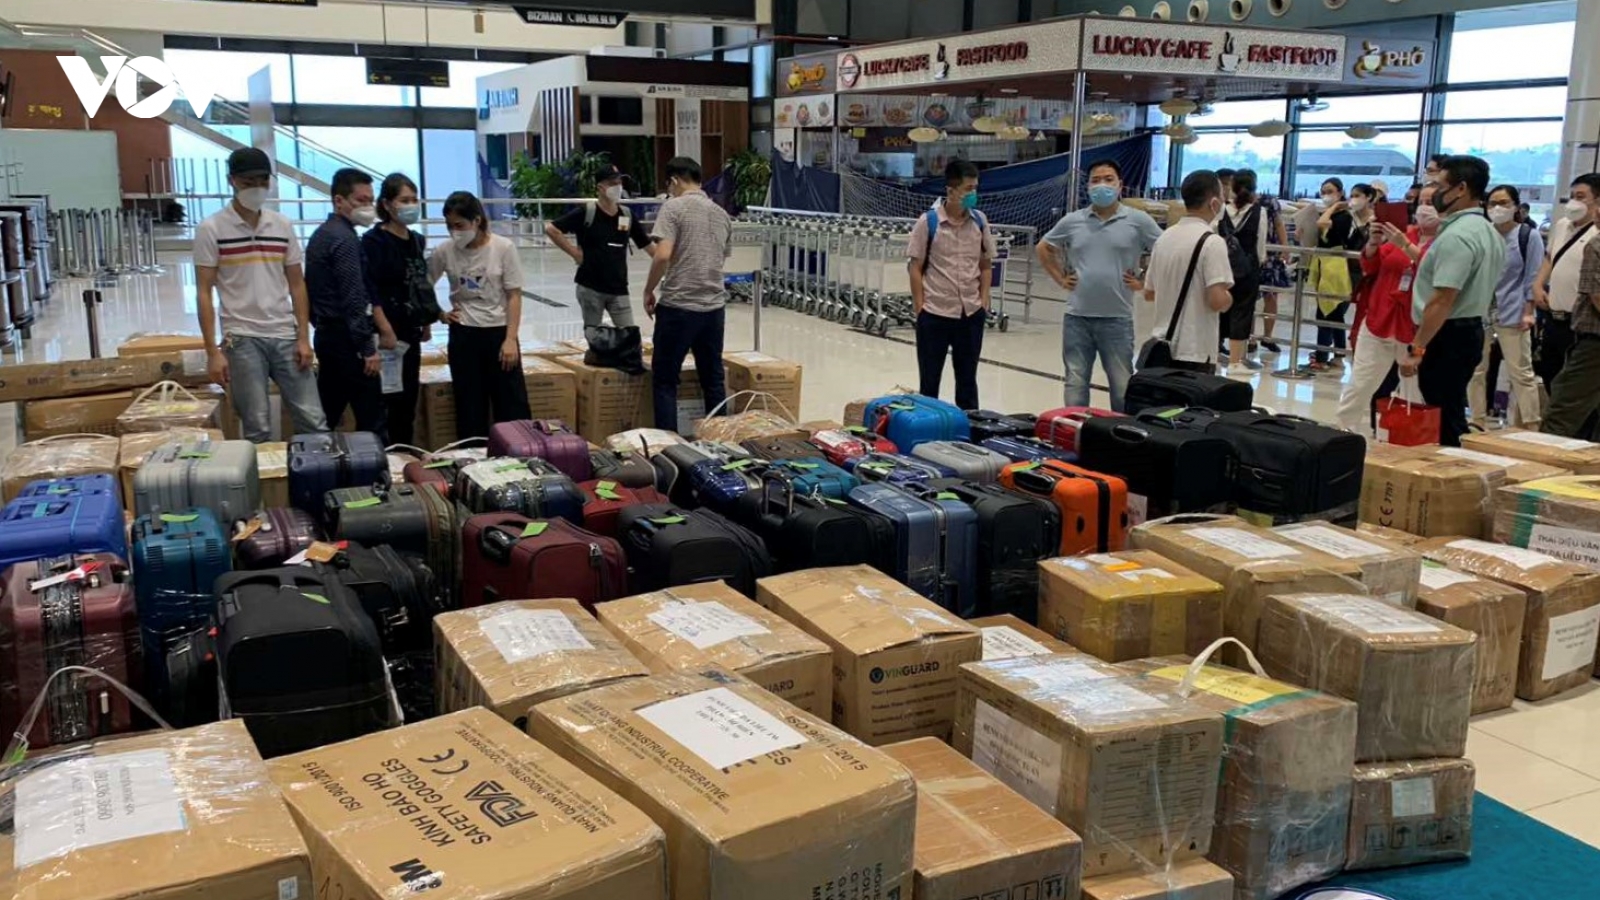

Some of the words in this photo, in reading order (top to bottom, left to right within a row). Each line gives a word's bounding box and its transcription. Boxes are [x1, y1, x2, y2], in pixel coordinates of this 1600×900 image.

[885, 661, 939, 680] VINGUARD
[787, 714, 811, 734] ISO
[623, 726, 670, 759] INDUSTRIAL
[666, 756, 730, 801] COOPERATIVE
[380, 758, 444, 809] GOGGLES
[337, 790, 364, 812] ISO
[463, 779, 538, 828] FDA
[438, 806, 491, 846] SAFETY
[571, 814, 599, 833] NHAT
